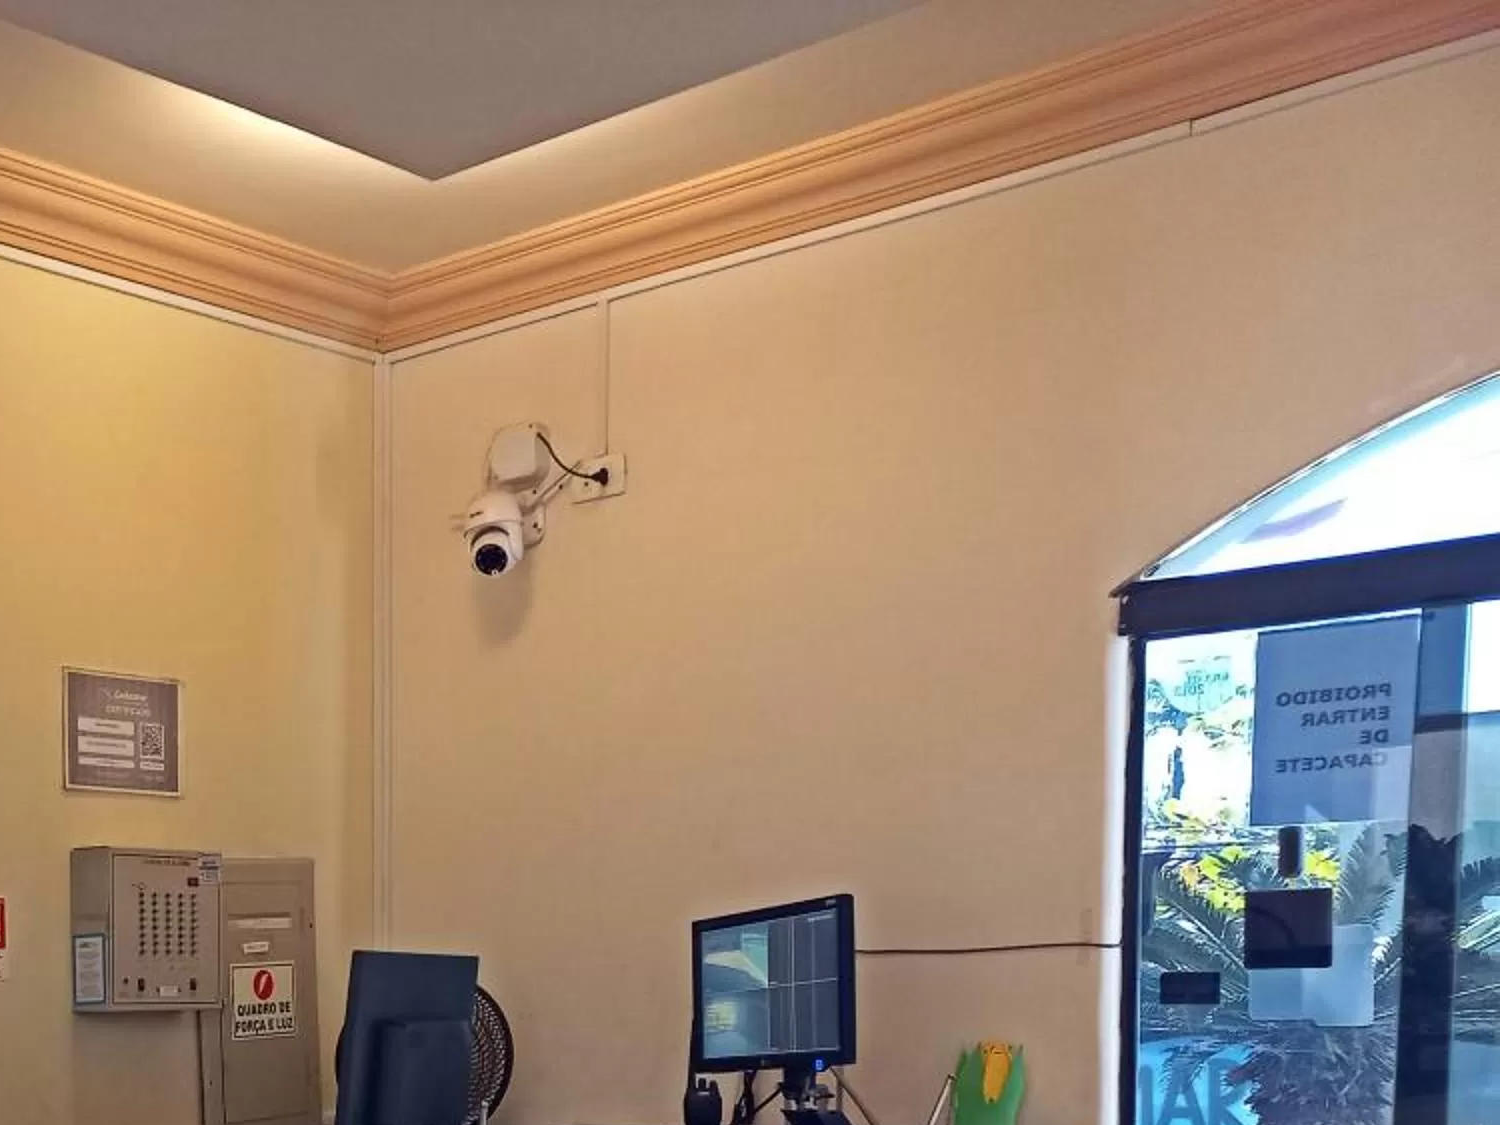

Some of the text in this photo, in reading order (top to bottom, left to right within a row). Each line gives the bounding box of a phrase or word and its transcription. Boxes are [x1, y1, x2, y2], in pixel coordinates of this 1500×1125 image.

[237, 1001, 291, 1017] QUADRO DE
[235, 1020, 267, 1035] FORÇA
[276, 1017, 293, 1030] LUZ
